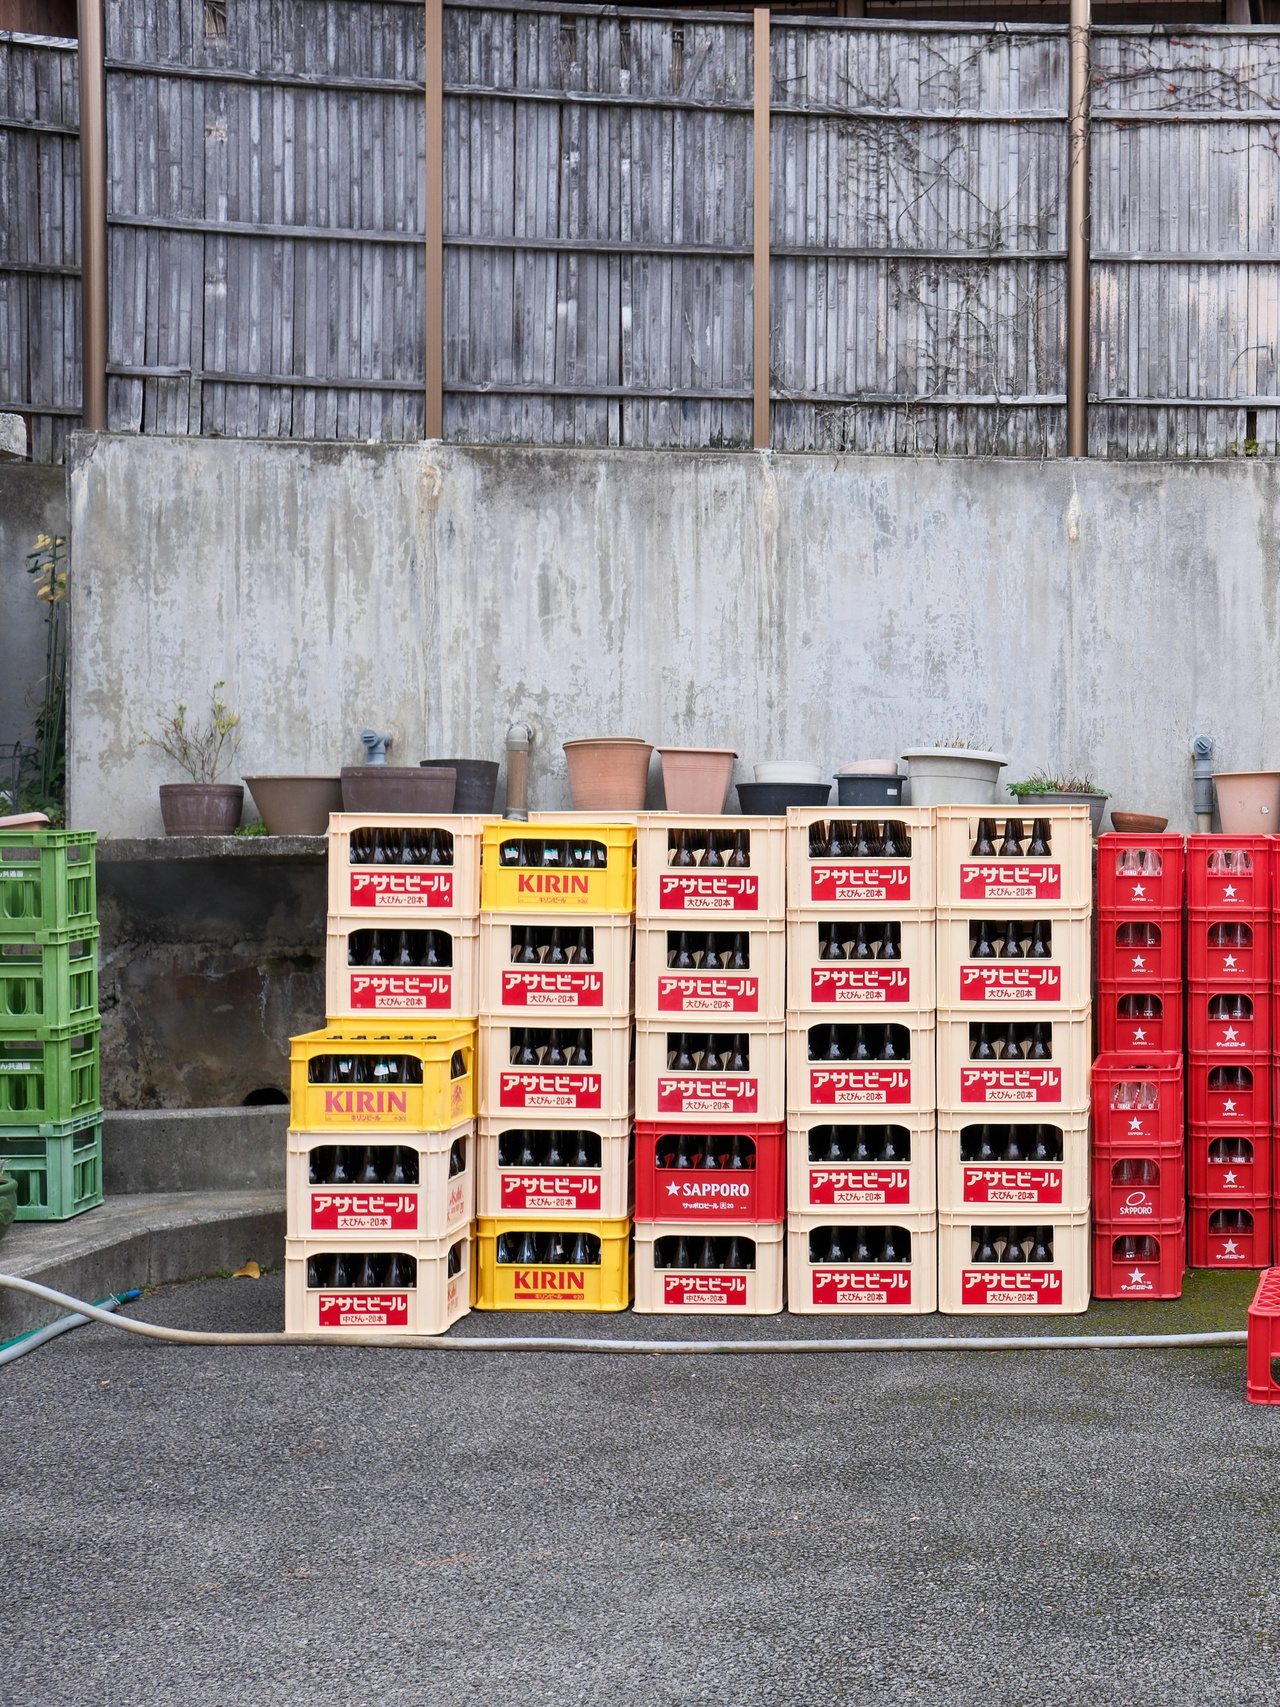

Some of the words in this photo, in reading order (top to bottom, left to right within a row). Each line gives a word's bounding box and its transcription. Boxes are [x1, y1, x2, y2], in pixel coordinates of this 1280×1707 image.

[353, 875, 450, 891] アサヒビール
[814, 870, 907, 884] アサヒビール
[963, 867, 1058, 883] アサヒビール
[518, 875, 588, 894] KIRIN
[663, 878, 755, 894] アサヒビール
[505, 974, 600, 990] アサヒビール
[814, 971, 907, 986] アサヒビール
[963, 969, 1058, 984] アサヒビール
[354, 977, 448, 993] アサヒビール
[661, 979, 755, 996] アサヒビール
[503, 1075, 598, 1092] アサヒビール
[813, 1072, 908, 1088] アサヒビール
[964, 1071, 1058, 1086] アサヒビール
[661, 1081, 755, 1097] アサヒビール
[325, 1090, 406, 1113] KIRIN
[505, 1178, 598, 1193] アサヒビール
[812, 1173, 907, 1188] アサヒビール
[967, 1171, 1059, 1187] アサヒビール
[682, 1183, 750, 1197] SAPPORO
[314, 1197, 415, 1213] アサヒビール
[514, 1271, 584, 1290] KIRIN
[666, 1278, 745, 1291] アサヒビール
[816, 1273, 908, 1288] アサヒビール
[965, 1273, 1059, 1288] アサヒビール
[321, 1297, 406, 1311] アサヒビール
